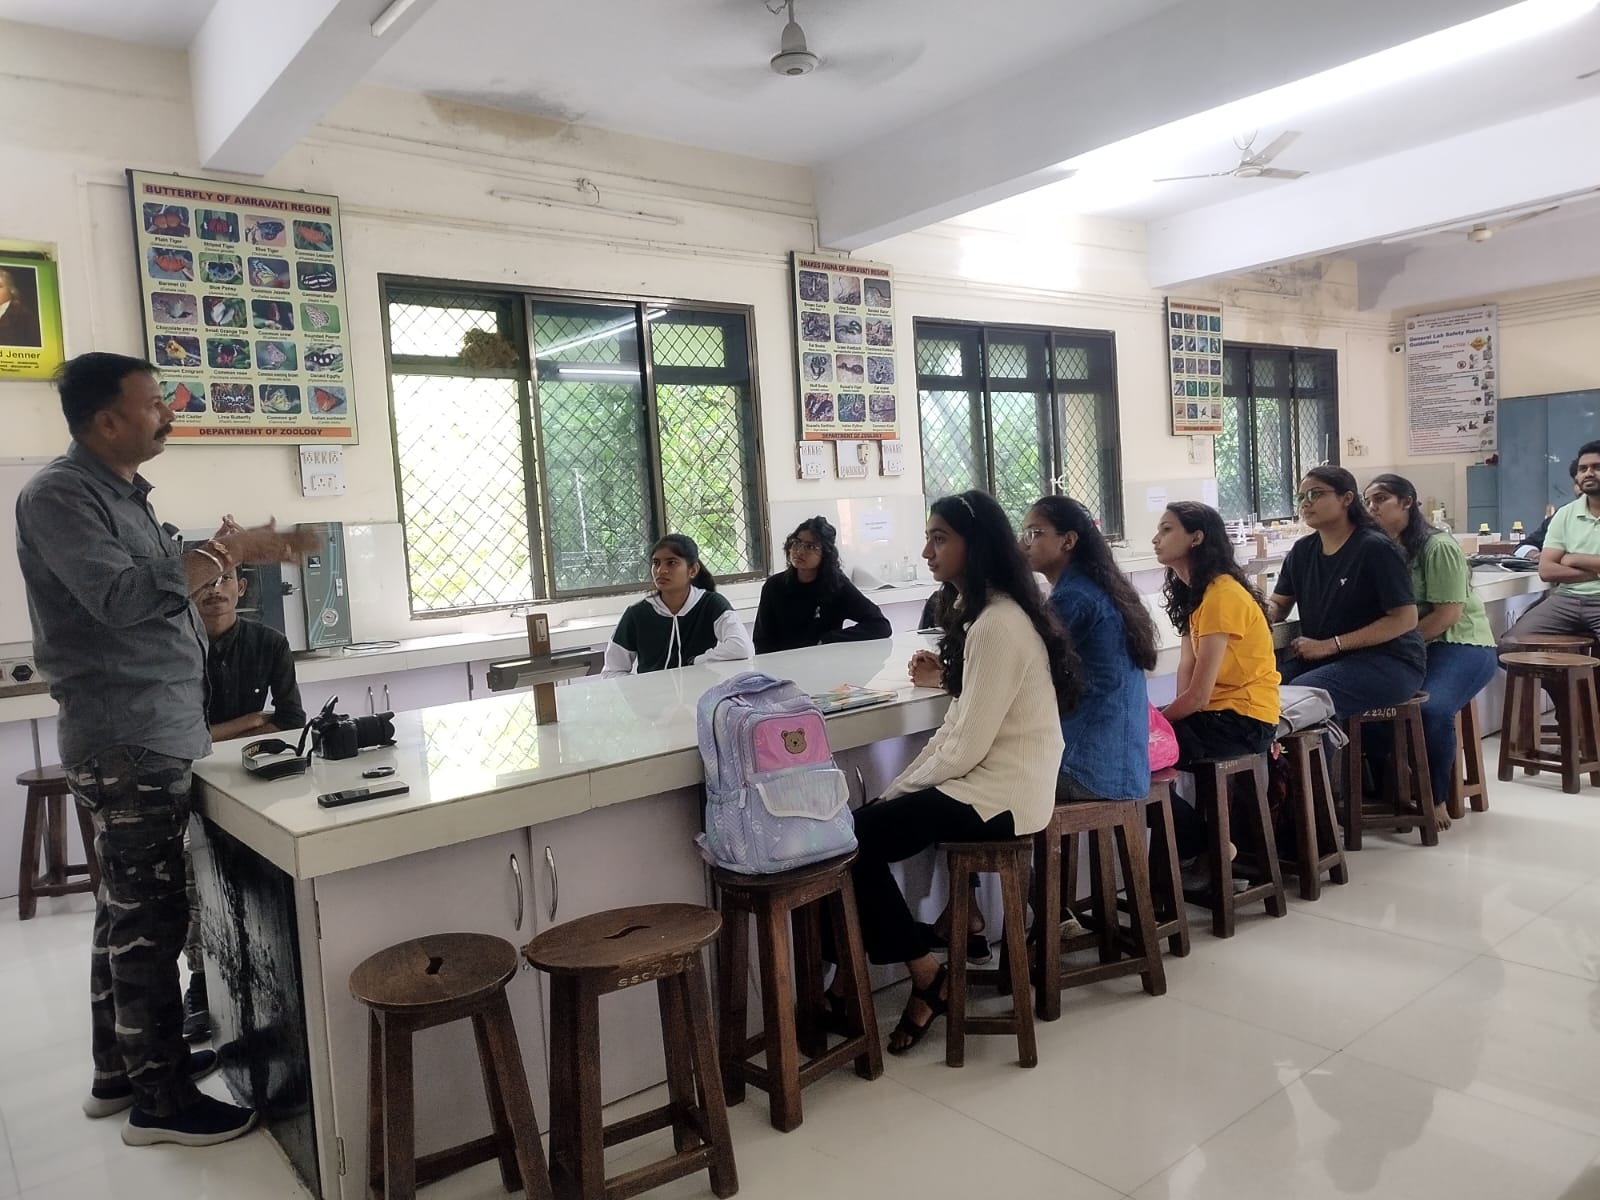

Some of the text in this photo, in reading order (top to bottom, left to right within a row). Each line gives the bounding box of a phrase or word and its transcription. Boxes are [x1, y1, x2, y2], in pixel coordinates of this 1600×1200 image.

[145, 184, 330, 215] BUTTERFLY OF AMRAVATI REGION
[800, 259, 821, 269] SNAKES
[821, 262, 838, 271] FAUNA
[1409, 334, 1432, 342] General
[6, 350, 41, 359] Jenner
[199, 427, 323, 436] DEPARTMENT OF ZOOLOGY
